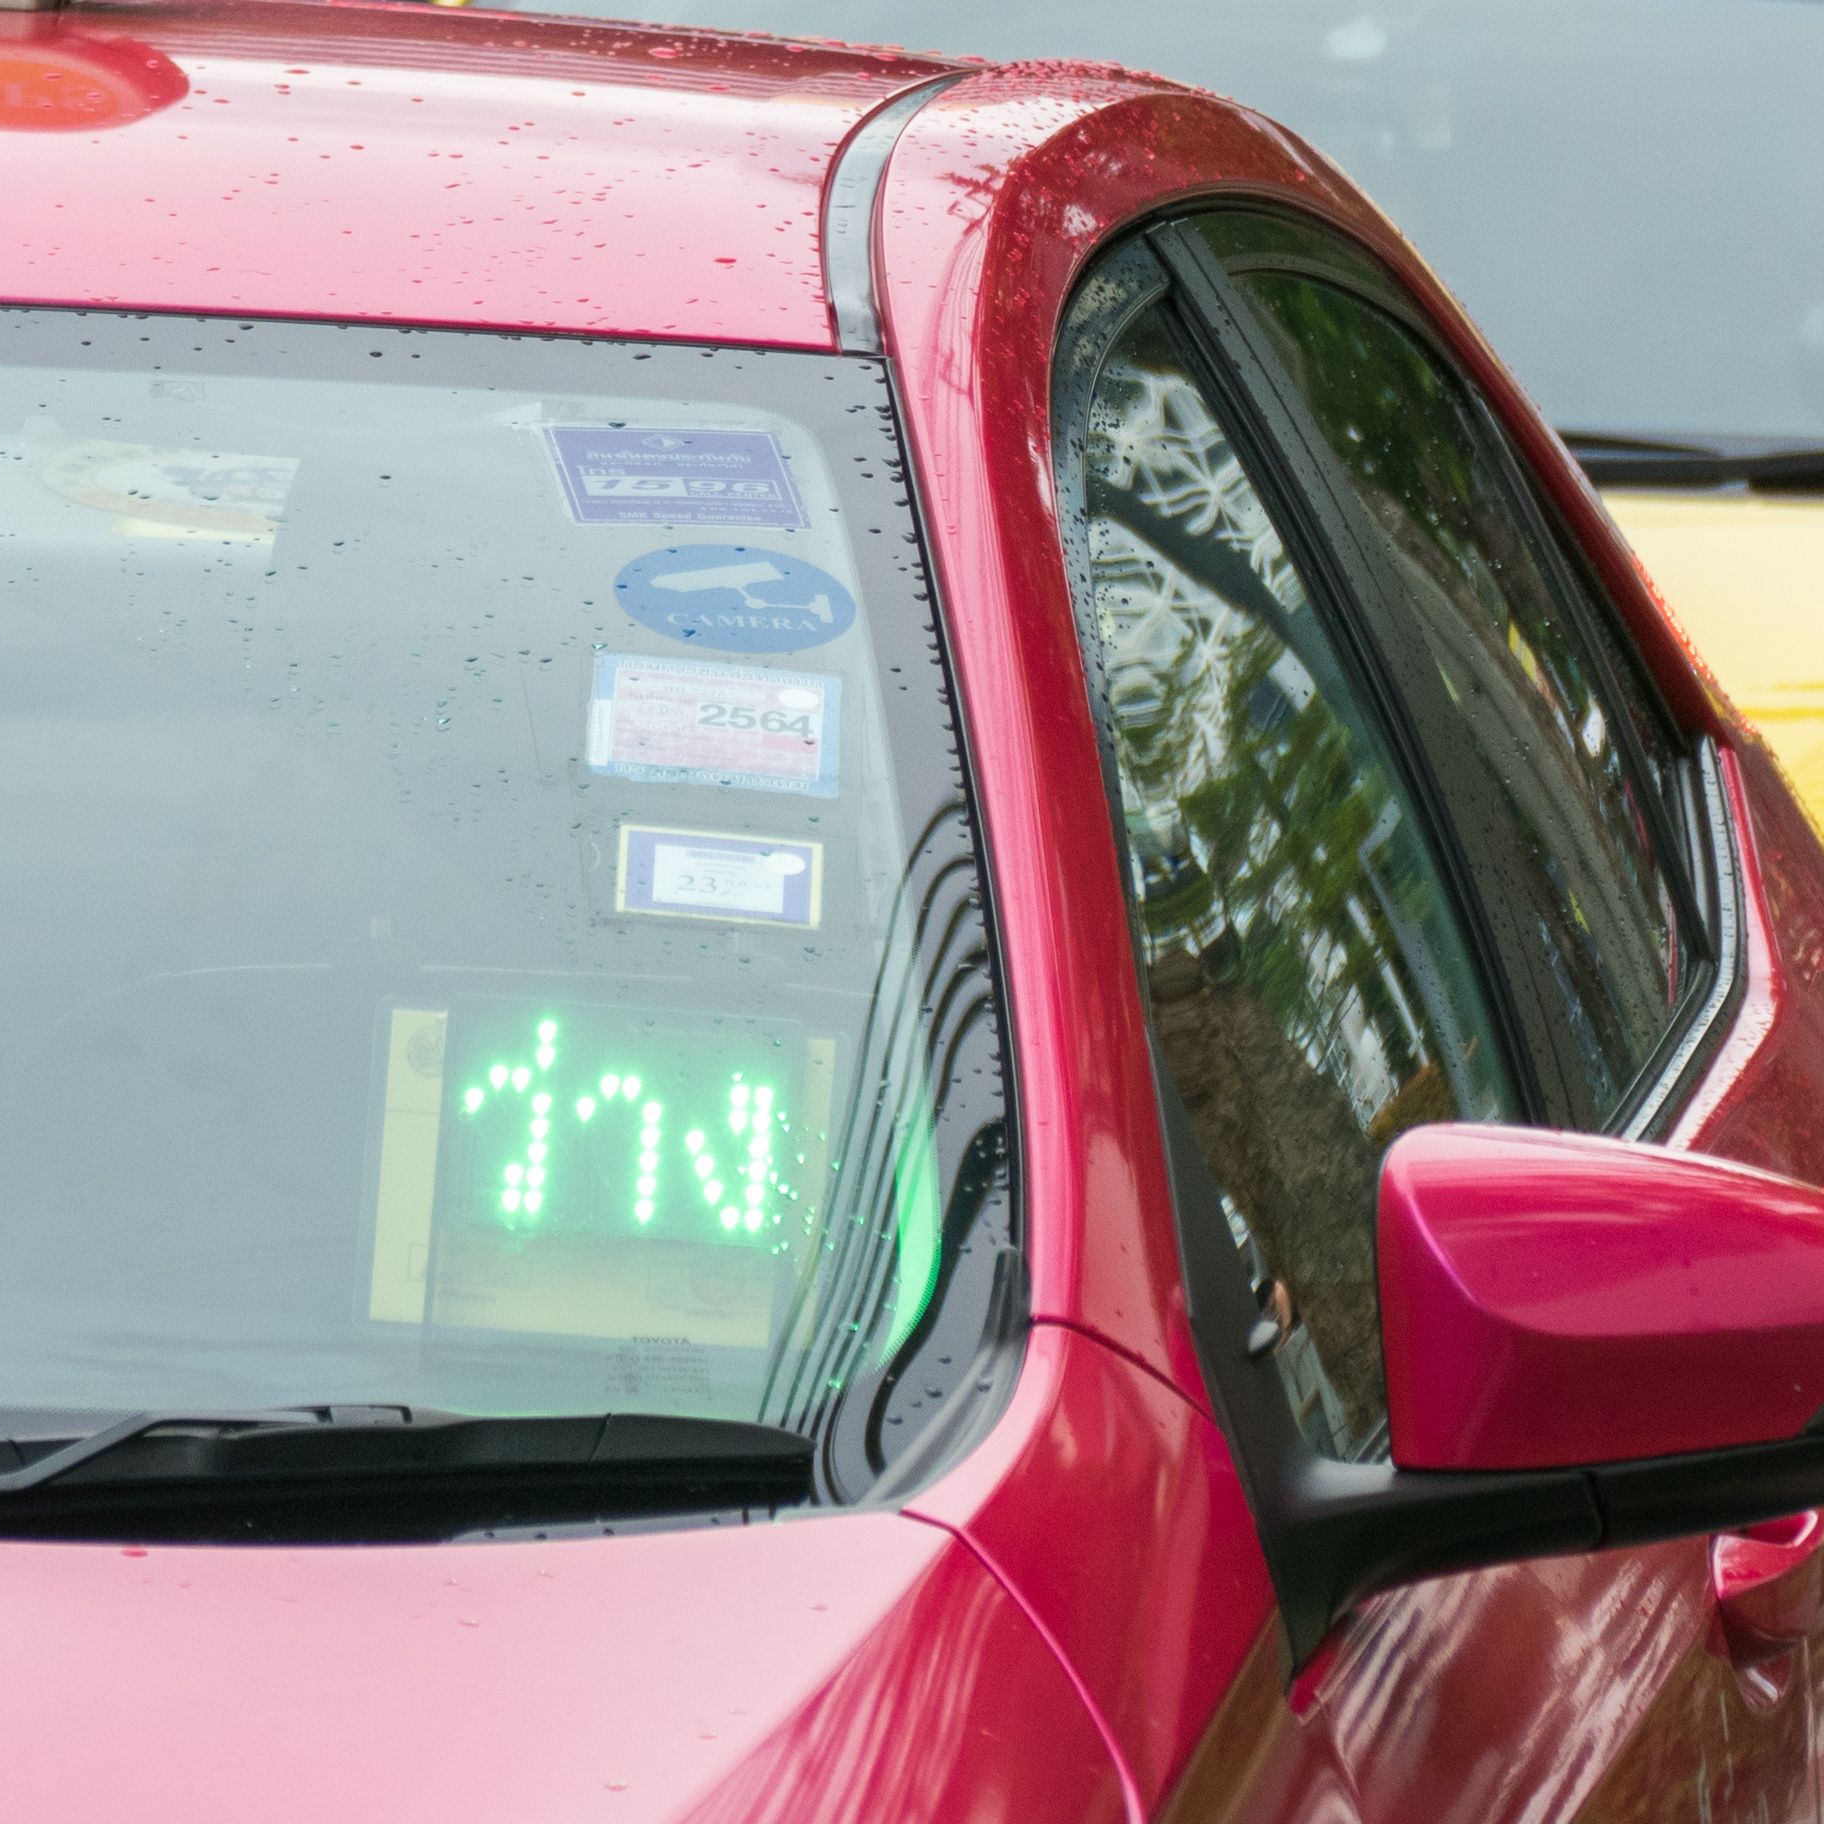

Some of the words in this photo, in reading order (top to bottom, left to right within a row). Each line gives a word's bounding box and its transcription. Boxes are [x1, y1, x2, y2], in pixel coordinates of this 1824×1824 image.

[666, 613, 818, 631] CAMERA
[697, 703, 814, 738] 2564
[462, 1018, 776, 1235] ว่าง
